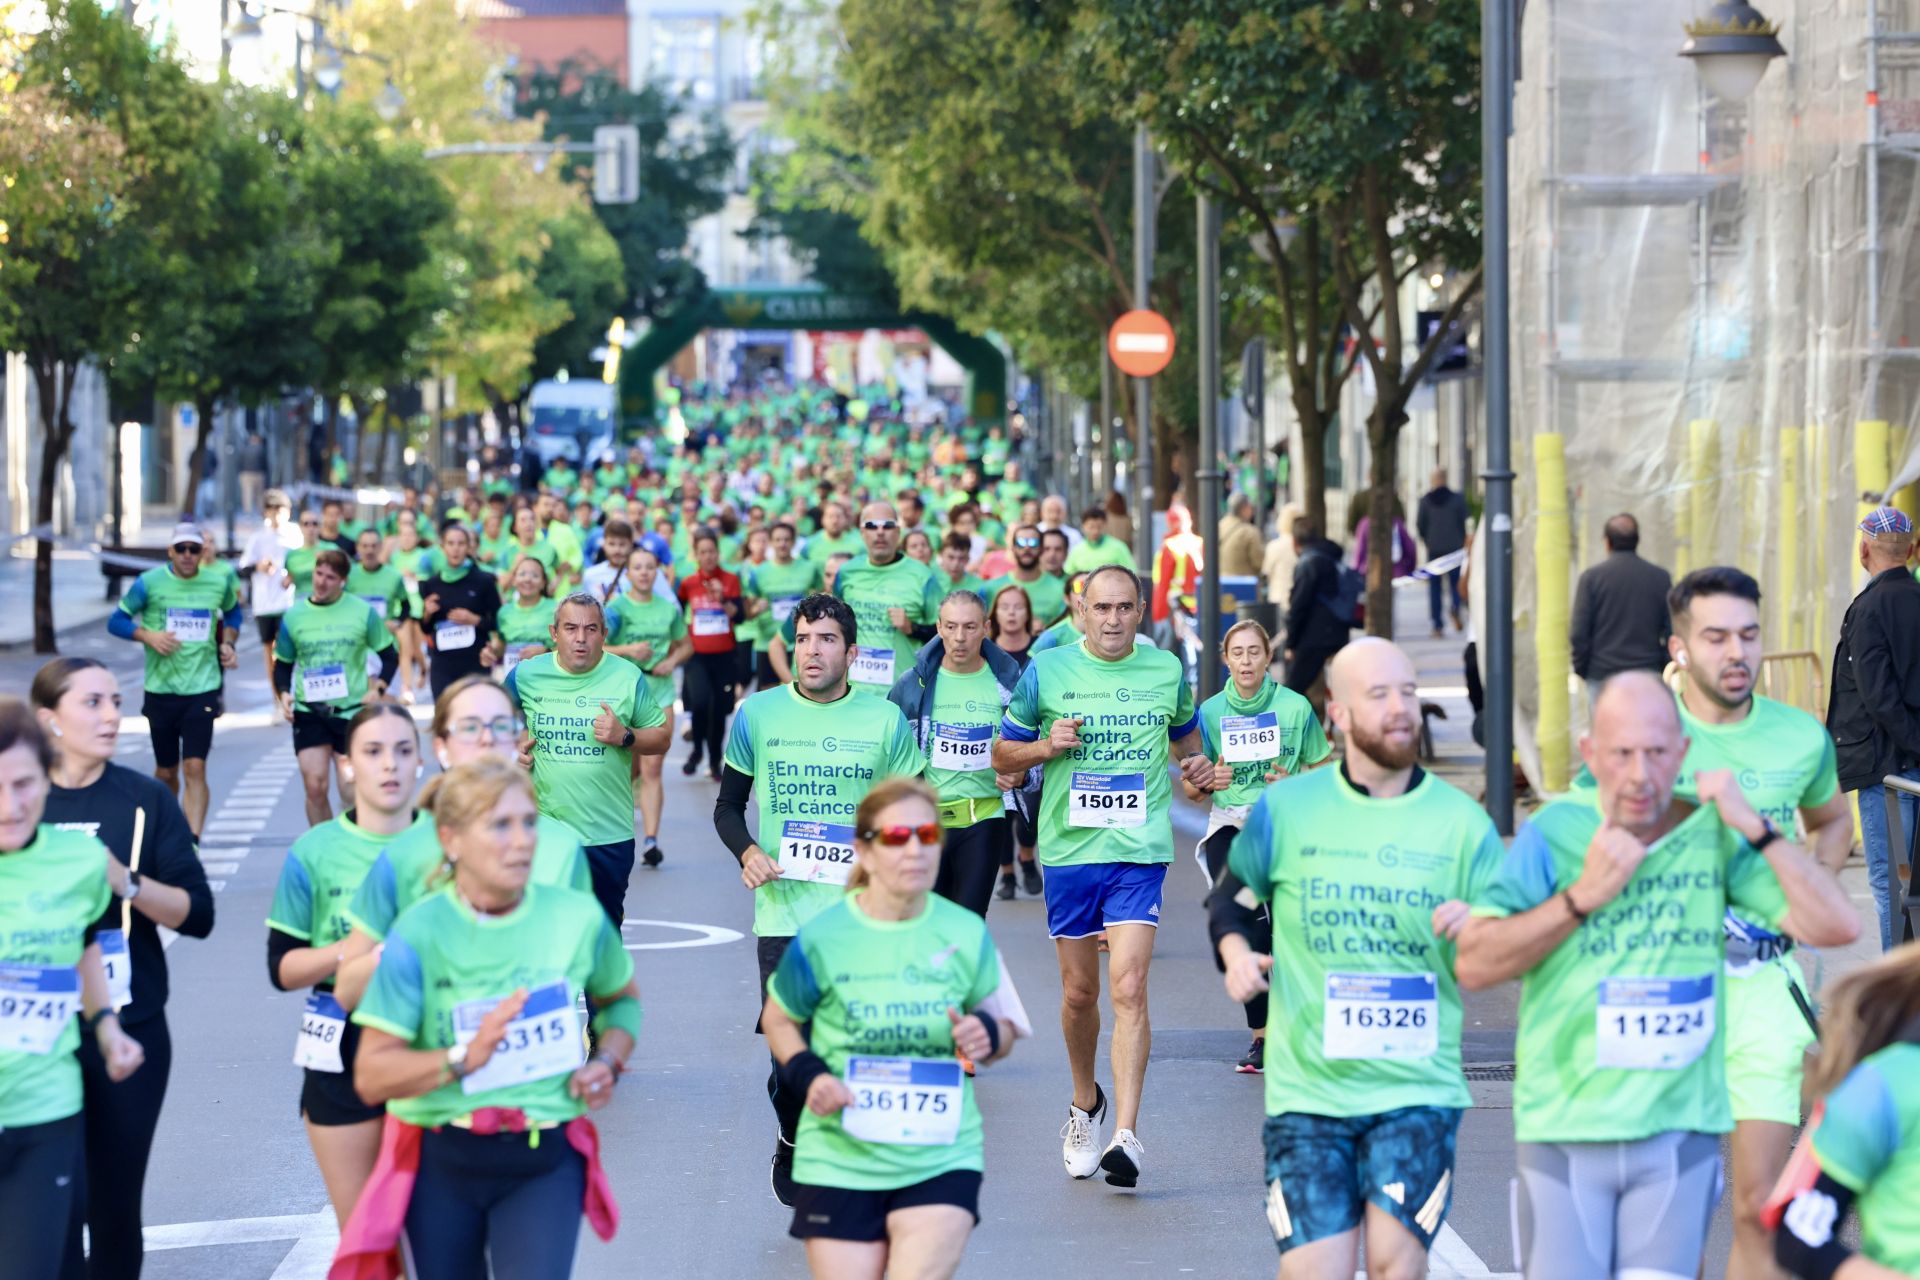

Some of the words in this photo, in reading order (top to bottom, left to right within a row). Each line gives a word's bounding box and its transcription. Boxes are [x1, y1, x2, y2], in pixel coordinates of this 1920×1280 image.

[1076, 692, 1111, 700] Iberdrola
[537, 713, 555, 726] En
[560, 715, 597, 727] marc
[1100, 711, 1165, 726] marcha
[537, 729, 586, 741] contra
[781, 739, 816, 747] Iberdrola
[1229, 730, 1275, 746] 51863
[554, 743, 607, 756] cáncer
[941, 741, 986, 755] 51862
[1073, 747, 1087, 761] el
[1092, 744, 1153, 761] cáncer
[776, 761, 798, 776] En
[804, 763, 873, 780] marcha
[777, 783, 837, 796] contra
[779, 799, 794, 814] el
[798, 799, 859, 815] cánce
[1078, 794, 1138, 808] 15012
[789, 842, 854, 864] 11082
[1310, 878, 1341, 899] En
[1350, 884, 1445, 909] marcha
[1310, 908, 1397, 930] contra
[1313, 932, 1336, 953] el
[1343, 935, 1430, 957] cáncer
[848, 1001, 878, 1021] En
[1341, 1007, 1426, 1028] 16326
[1615, 1009, 1705, 1036] 11224
[853, 1024, 929, 1043] contra
[858, 1088, 948, 1114] 36175
